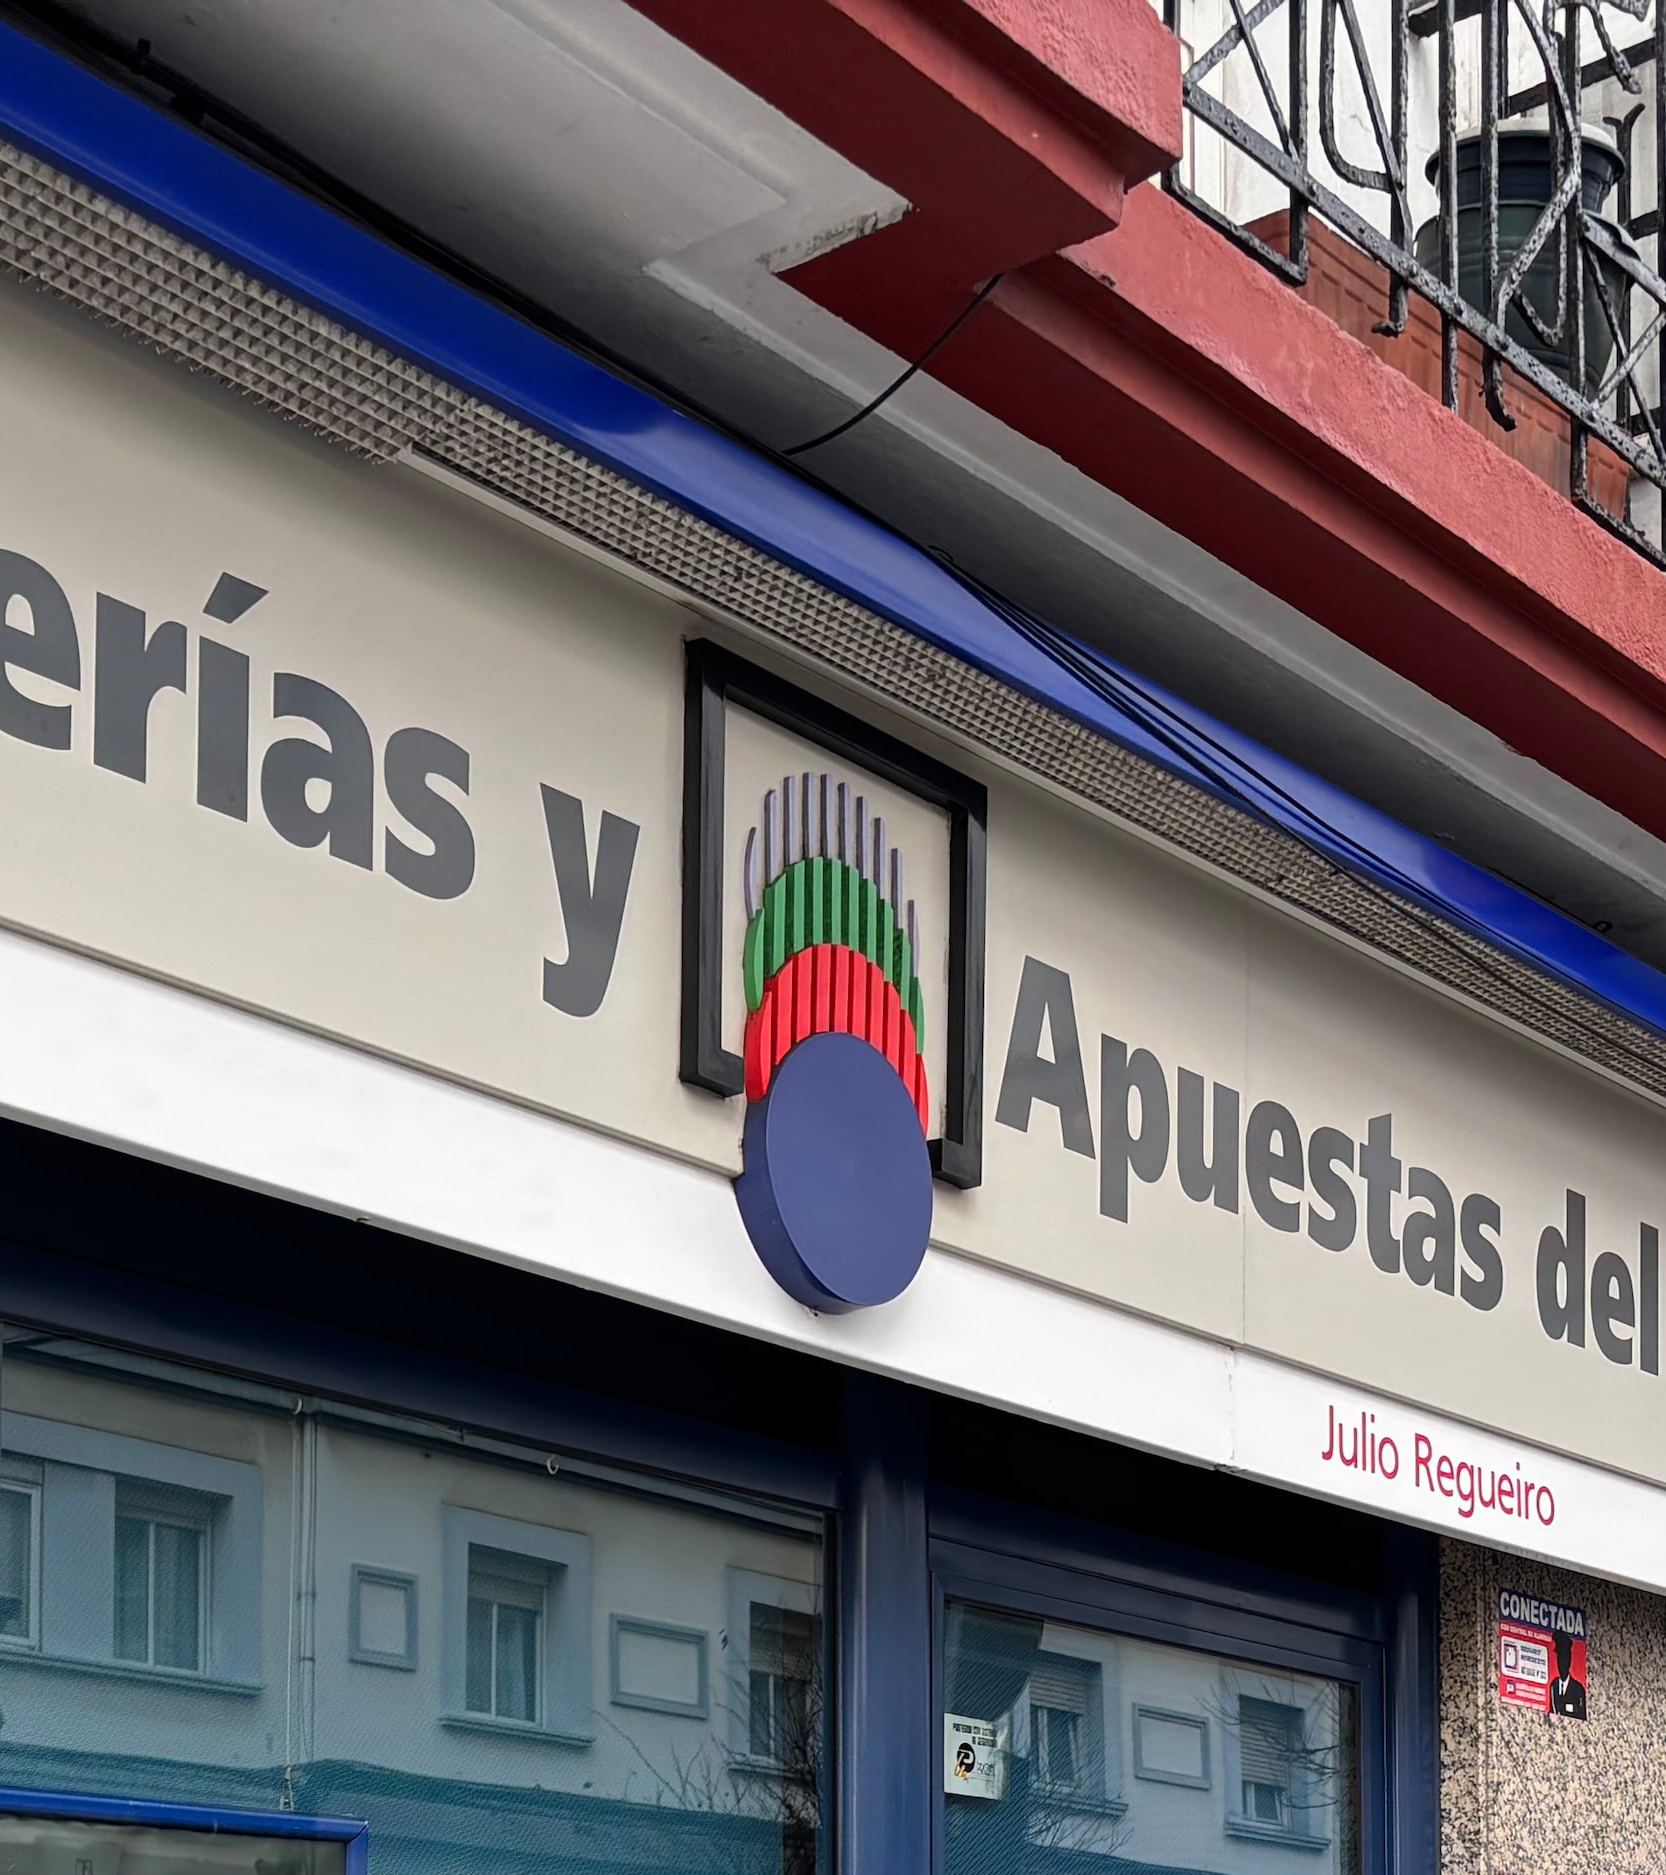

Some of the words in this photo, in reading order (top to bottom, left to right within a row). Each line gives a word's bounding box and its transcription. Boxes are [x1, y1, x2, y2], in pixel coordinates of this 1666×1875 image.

[540, 782, 641, 1018] y
[995, 954, 1503, 1311] Apuestas
[1536, 1189, 1659, 1375] del
[1322, 1404, 1399, 1480] Julio
[1414, 1433, 1555, 1526] Regueiro
[1500, 1592, 1584, 1636] CONECTADA
